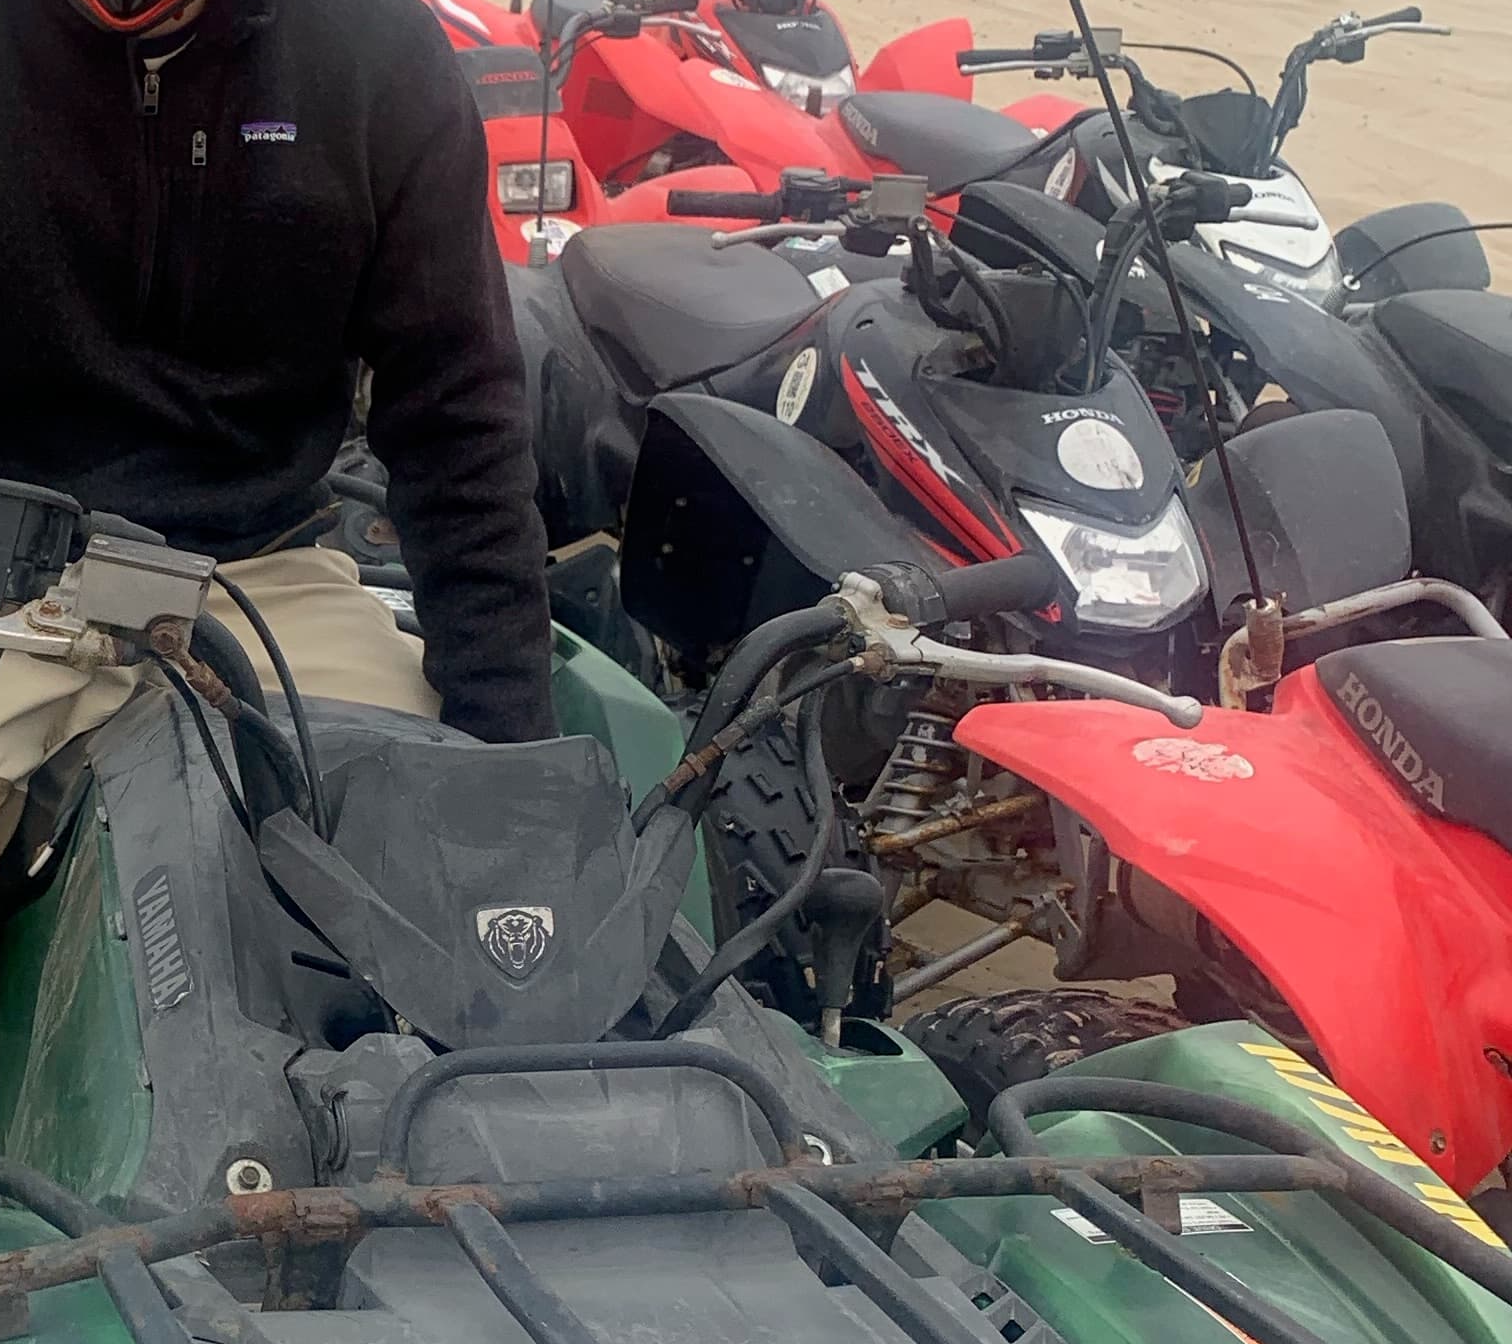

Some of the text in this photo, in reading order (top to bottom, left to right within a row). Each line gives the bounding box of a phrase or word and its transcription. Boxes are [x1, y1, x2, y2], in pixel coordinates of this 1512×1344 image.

[244, 131, 296, 144] patagonia
[1253, 190, 1296, 204] ONDA
[855, 357, 976, 494] TRX
[1041, 407, 1125, 426] HONDA
[1336, 671, 1446, 813] HONDA
[136, 874, 189, 1006] YAMAHA
